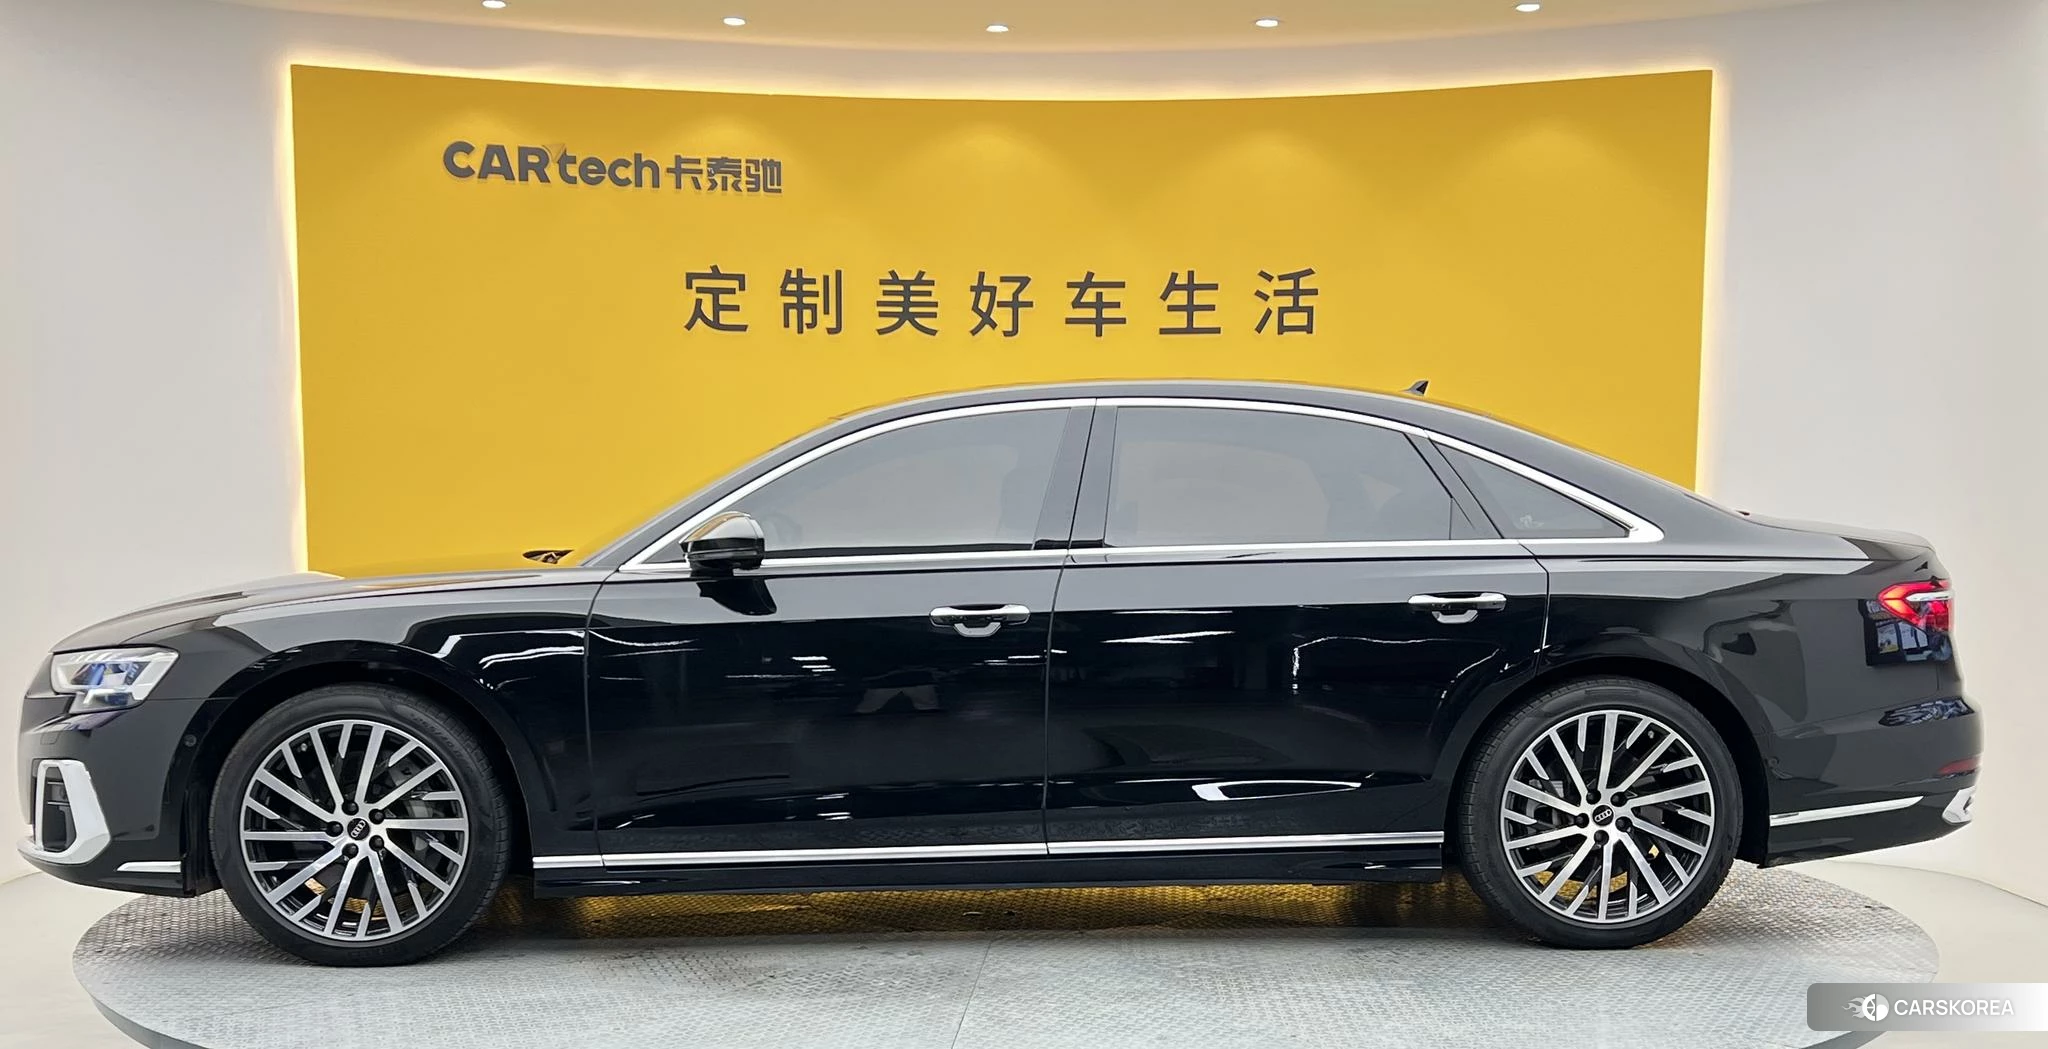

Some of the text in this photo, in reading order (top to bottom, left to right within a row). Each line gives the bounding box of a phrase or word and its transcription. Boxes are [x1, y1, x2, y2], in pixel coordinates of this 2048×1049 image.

[443, 141, 782, 194] CARtech 卡泰驰
[684, 264, 1320, 338] 定制美好车生活
